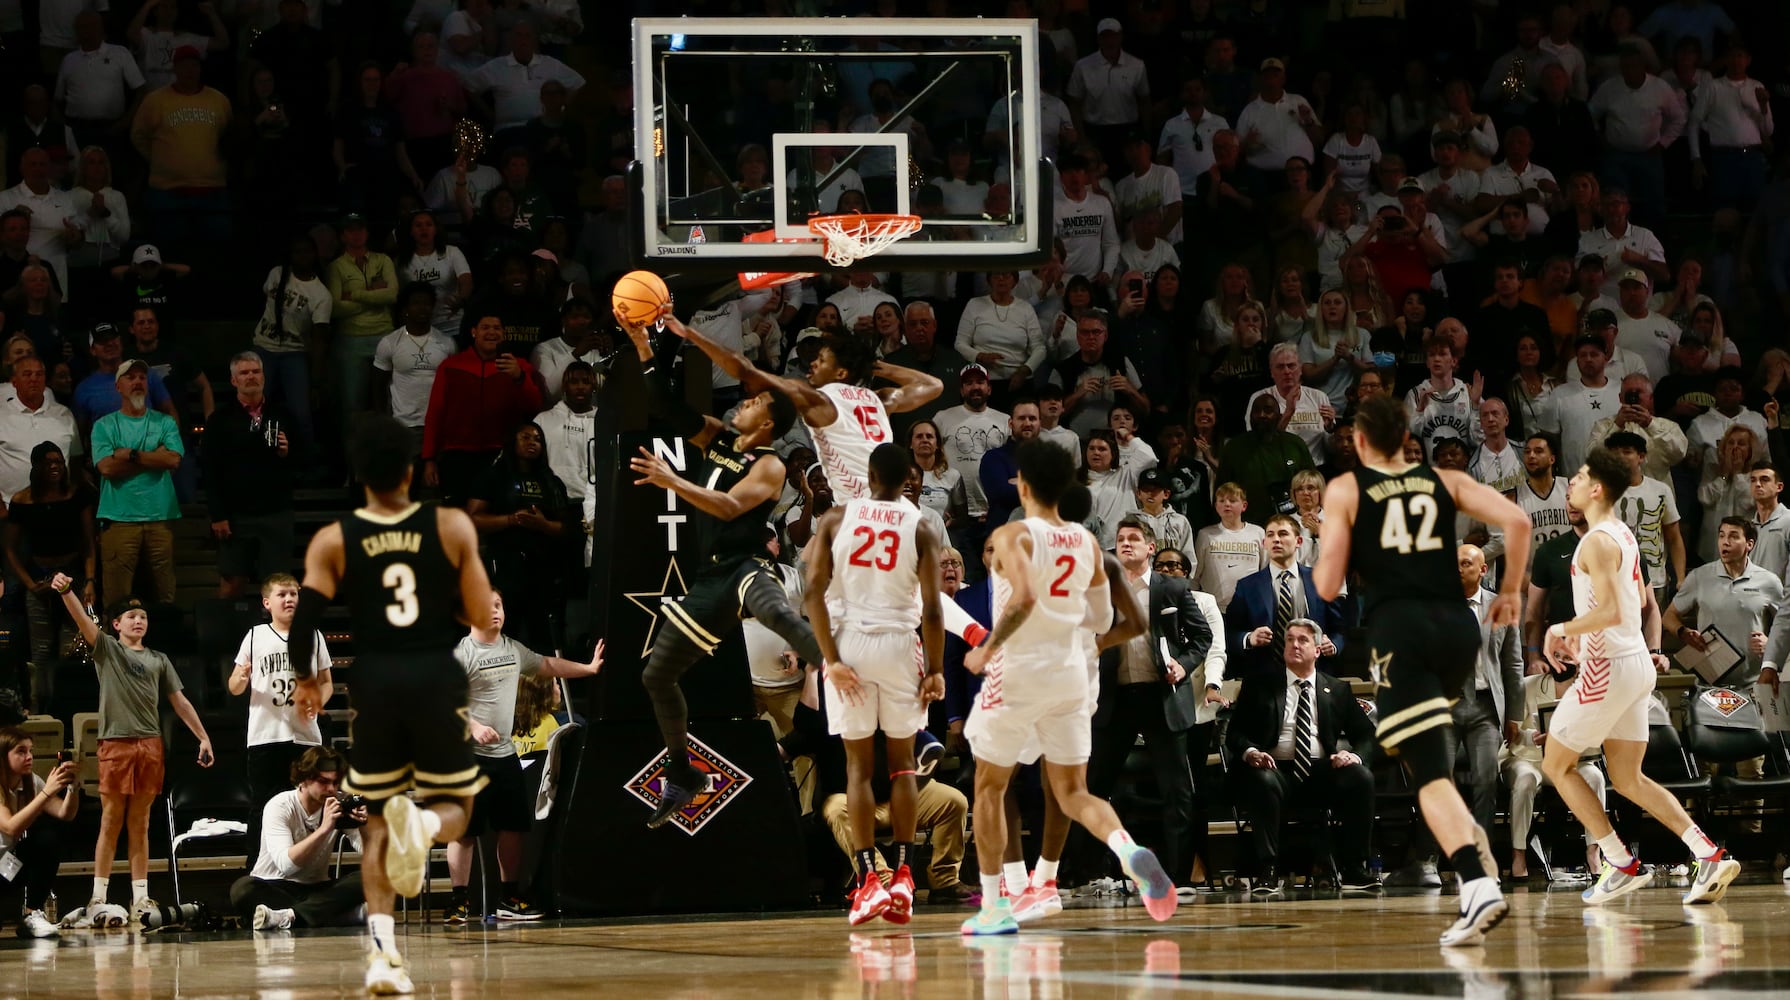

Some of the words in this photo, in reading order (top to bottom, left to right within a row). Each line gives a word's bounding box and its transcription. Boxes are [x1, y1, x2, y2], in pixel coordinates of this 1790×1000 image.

[168, 107, 217, 128] VANDERBILT
[657, 246, 697, 255] SPALDING
[853, 405, 885, 442] 15
[1291, 411, 1318, 422] ERBILT
[858, 505, 905, 526] BLAKNEY
[1380, 493, 1444, 554] 42
[849, 525, 901, 572] 23
[1050, 554, 1076, 597] 2
[382, 561, 420, 628] 3
[479, 654, 516, 667] VANDERBILT
[272, 678, 297, 707] 32
[687, 741, 739, 779] INVITATION
